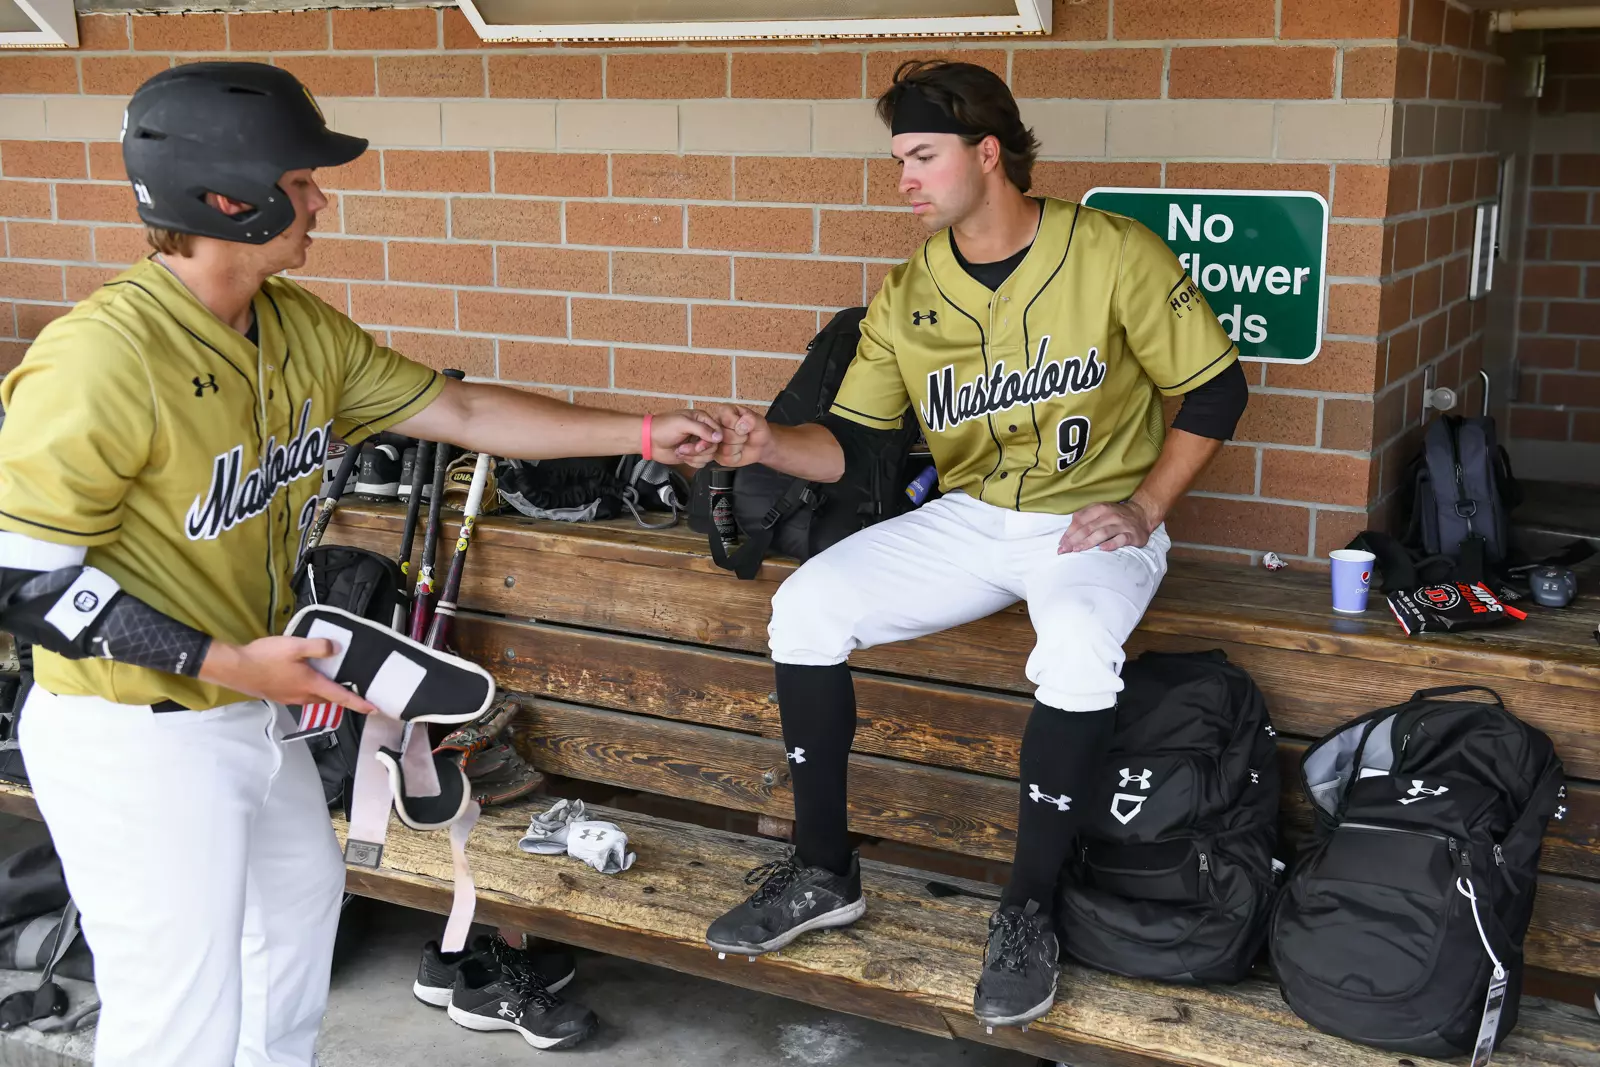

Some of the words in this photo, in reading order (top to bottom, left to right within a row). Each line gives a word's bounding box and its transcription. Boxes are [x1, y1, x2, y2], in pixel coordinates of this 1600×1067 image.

[1167, 203, 1234, 243] No
[920, 335, 1107, 432] Mastodons
[1057, 415, 1091, 472] 9
